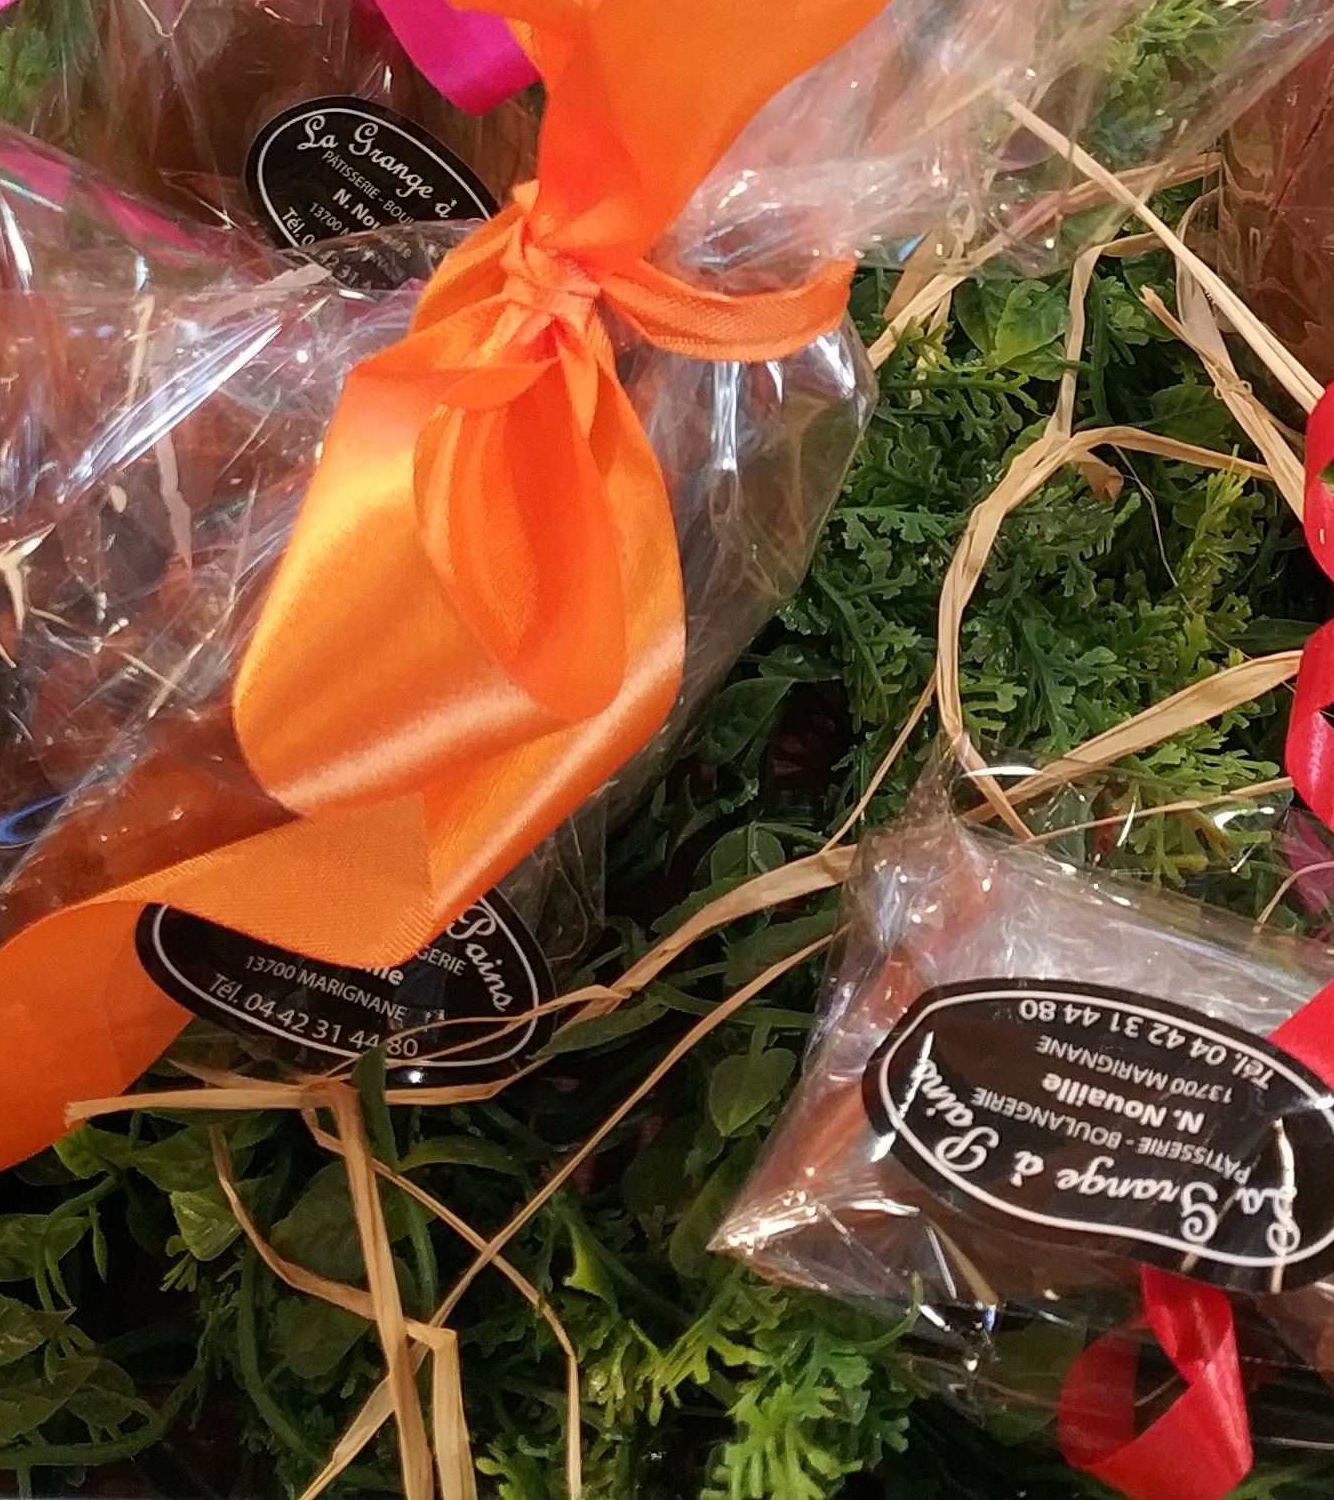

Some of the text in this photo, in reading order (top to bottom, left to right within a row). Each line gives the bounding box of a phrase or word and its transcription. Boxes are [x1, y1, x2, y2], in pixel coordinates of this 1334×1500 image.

[296, 115, 339, 151] La
[348, 122, 434, 199] Grange
[434, 198, 458, 219] à
[332, 188, 350, 210] N.
[280, 206, 303, 239] Tél.
[308, 202, 343, 232] 13700
[245, 955, 295, 980] 13700
[296, 968, 408, 1021] MARIGNANE
[445, 905, 514, 1012] Pains
[209, 973, 418, 1057] Tél. 04 42 31 44 80
[1019, 999, 1274, 1091] Tél. 04 42 31 44 80
[1036, 1035, 1233, 1104] 13700 MARIGNANE
[972, 1085, 1119, 1151] BOULANGERIE
[1043, 1073, 1205, 1134] N. Nouaille
[918, 1059, 1300, 1253] La Grange à Pains
